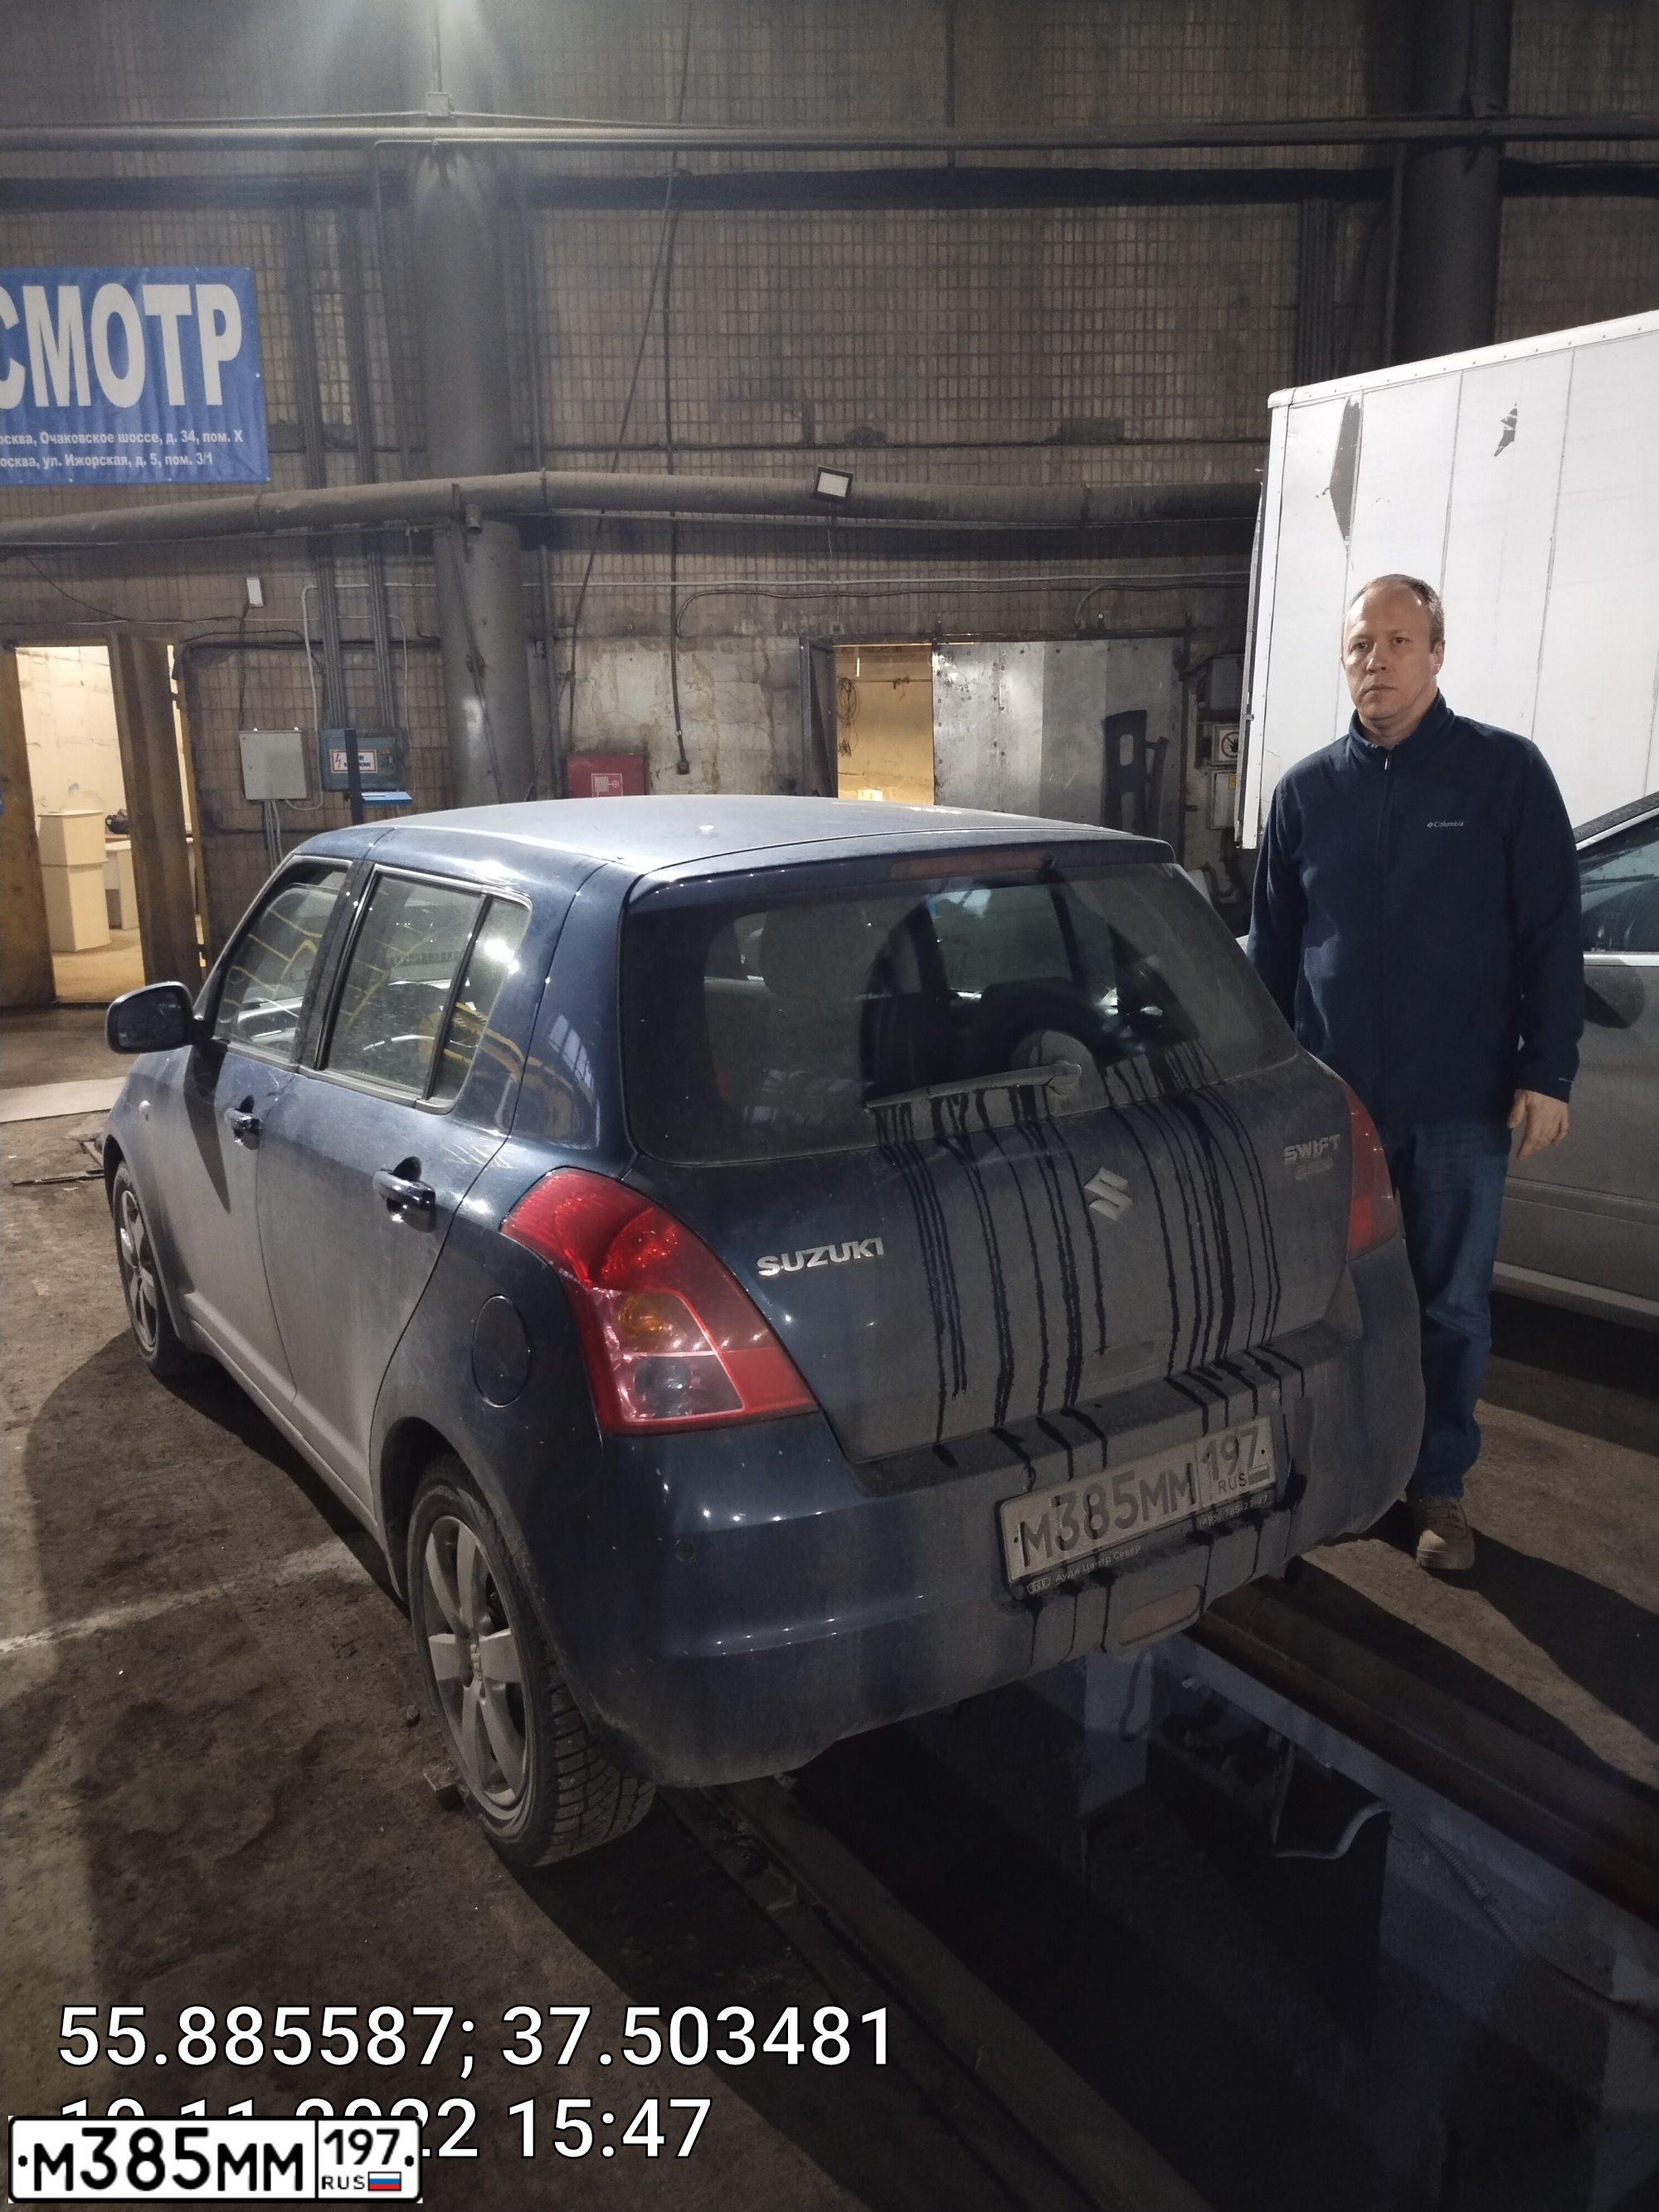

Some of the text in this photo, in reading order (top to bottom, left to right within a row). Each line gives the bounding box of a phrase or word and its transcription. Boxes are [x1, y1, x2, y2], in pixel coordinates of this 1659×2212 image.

[40, 431, 114, 444] Очаковское
[118, 433, 163, 446] шоссе,
[166, 432, 178, 445] д.
[180, 430, 199, 445] 34,
[202, 432, 231, 442] пом.
[42, 457, 61, 470] ул.
[65, 454, 132, 469] Ижорская,
[135, 456, 147, 467] д.
[150, 452, 162, 468] 5,
[165, 456, 192, 465] пом.
[197, 452, 213, 465] 3/1
[1283, 1133, 1341, 1165] SWIFT
[757, 1237, 884, 1276] SUZUKI
[1200, 1425, 1259, 1481] 197
[1218, 1472, 1247, 1494] RUS
[1054, 1569, 1080, 1583] Ауди
[1113, 1545, 1141, 1561] Север
